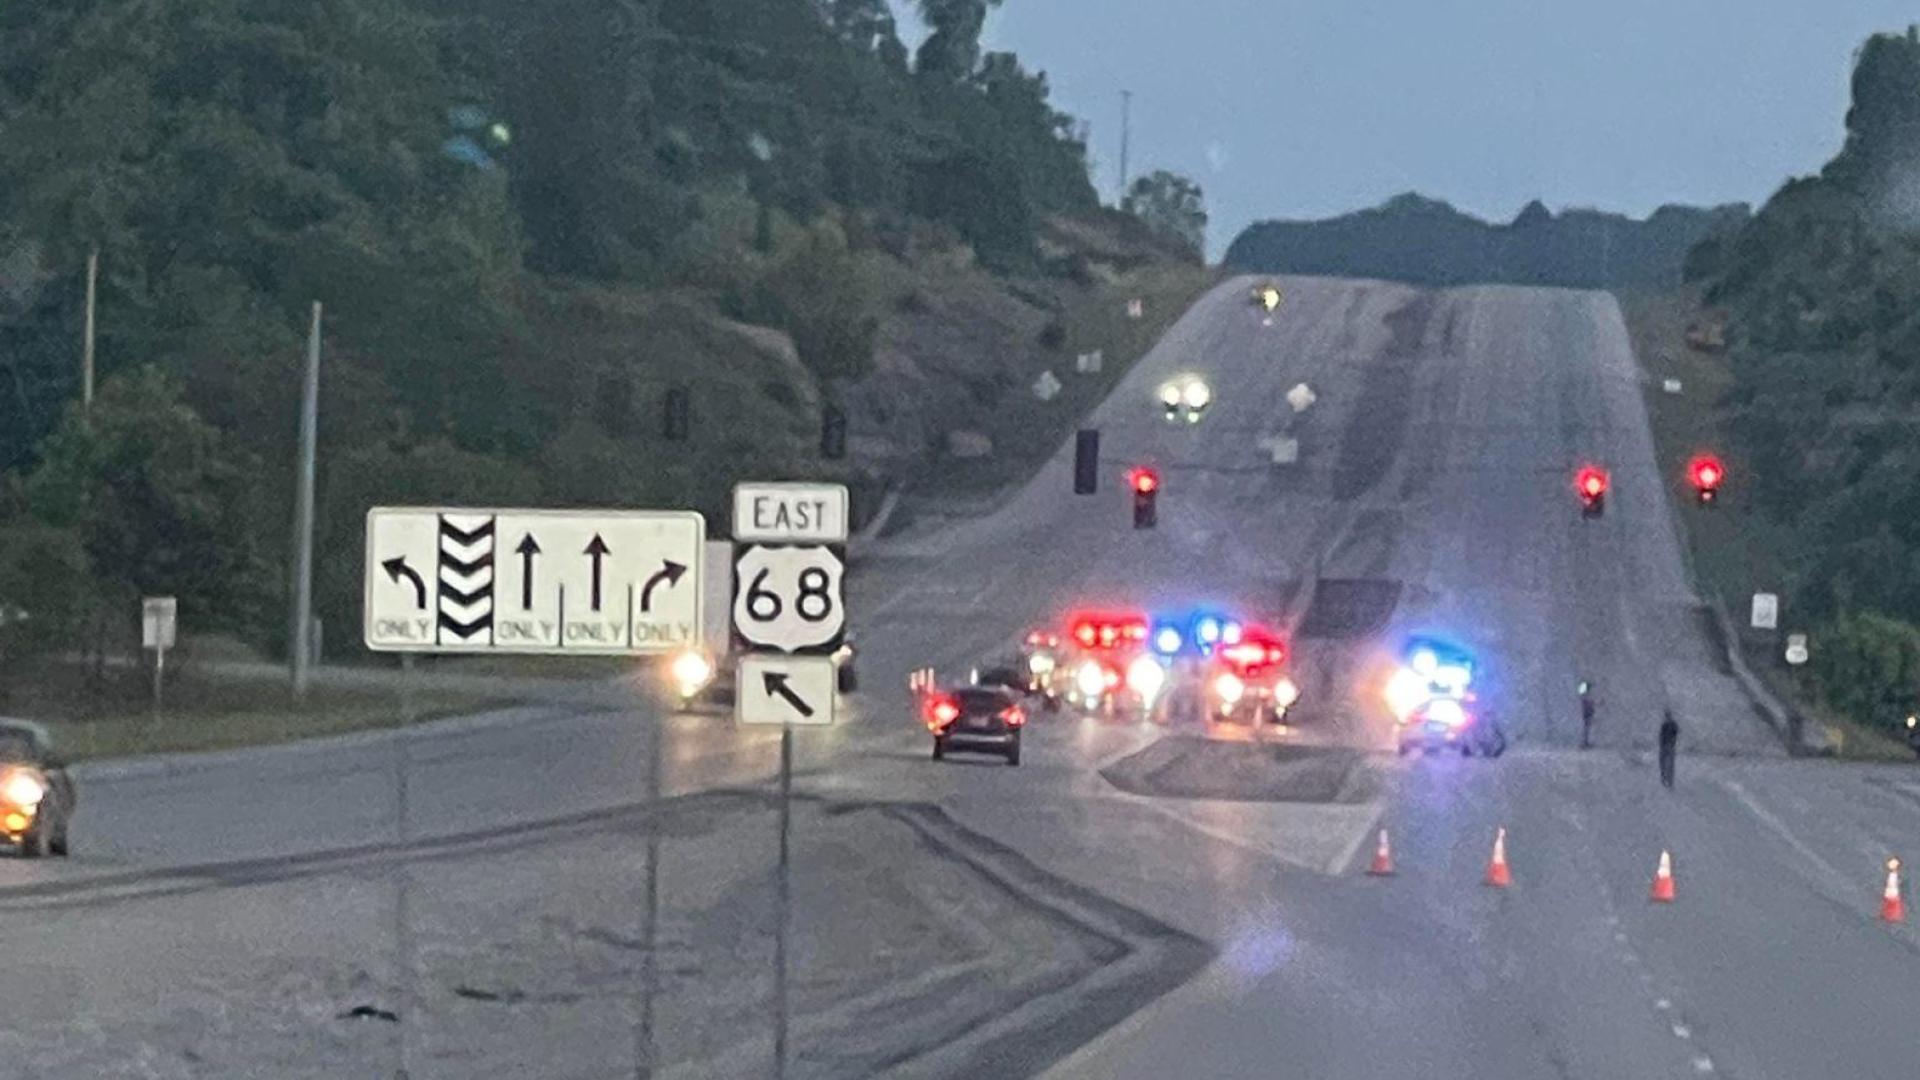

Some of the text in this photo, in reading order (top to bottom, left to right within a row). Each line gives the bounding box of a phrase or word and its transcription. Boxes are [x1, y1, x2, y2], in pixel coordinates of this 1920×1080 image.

[754, 496, 827, 530] EAST
[746, 566, 830, 622] 68
[375, 617, 430, 639] ONLY
[498, 618, 555, 640] ONLY
[566, 618, 624, 640] ONLY
[637, 618, 691, 641] ONLY
